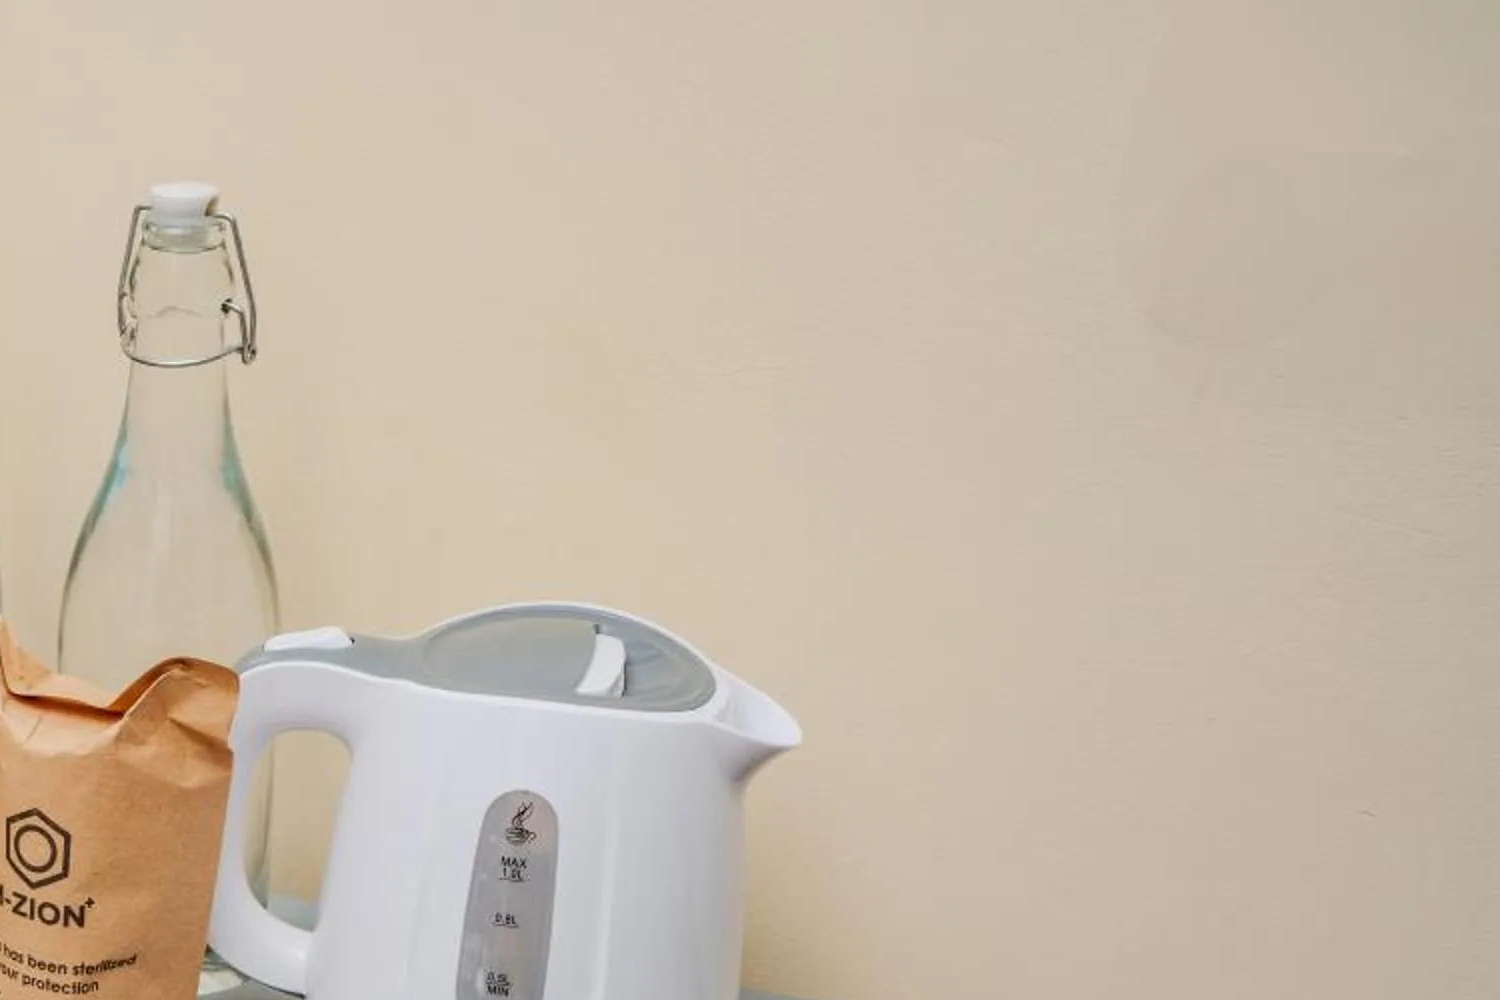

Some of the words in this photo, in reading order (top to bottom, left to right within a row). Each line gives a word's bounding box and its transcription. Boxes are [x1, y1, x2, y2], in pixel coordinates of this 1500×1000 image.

[501, 856, 527, 868] MAX
[3, 943, 25, 964] has
[27, 957, 68, 976] been
[72, 952, 138, 977] sterilized
[21, 973, 100, 995] protection
[487, 985, 509, 998] MIN
